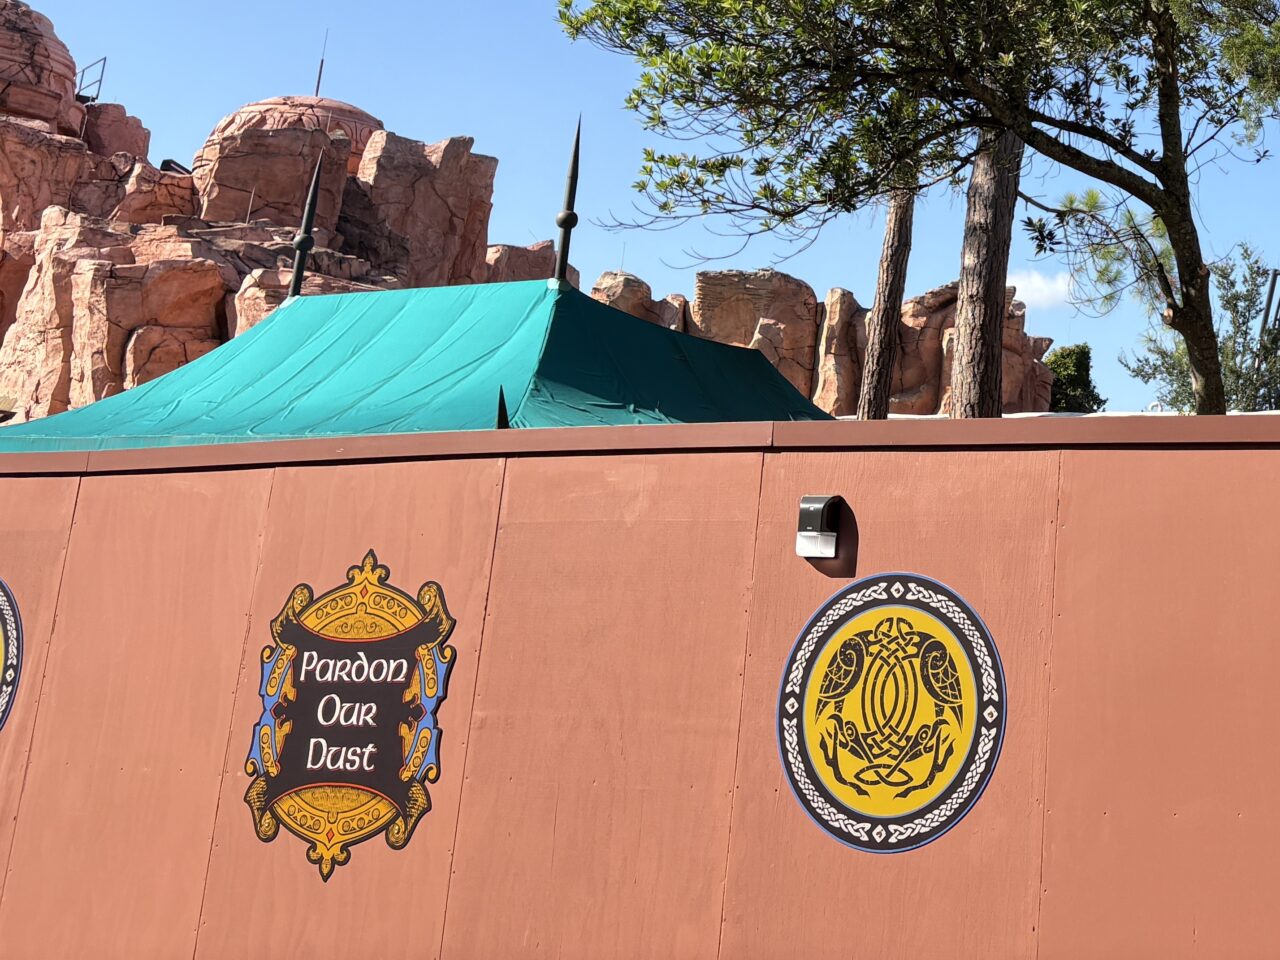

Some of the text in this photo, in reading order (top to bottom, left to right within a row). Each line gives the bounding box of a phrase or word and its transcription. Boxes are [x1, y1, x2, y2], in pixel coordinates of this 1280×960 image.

[300, 651, 408, 682] Pardon
[317, 693, 378, 726] Our
[306, 737, 377, 772] Dust
